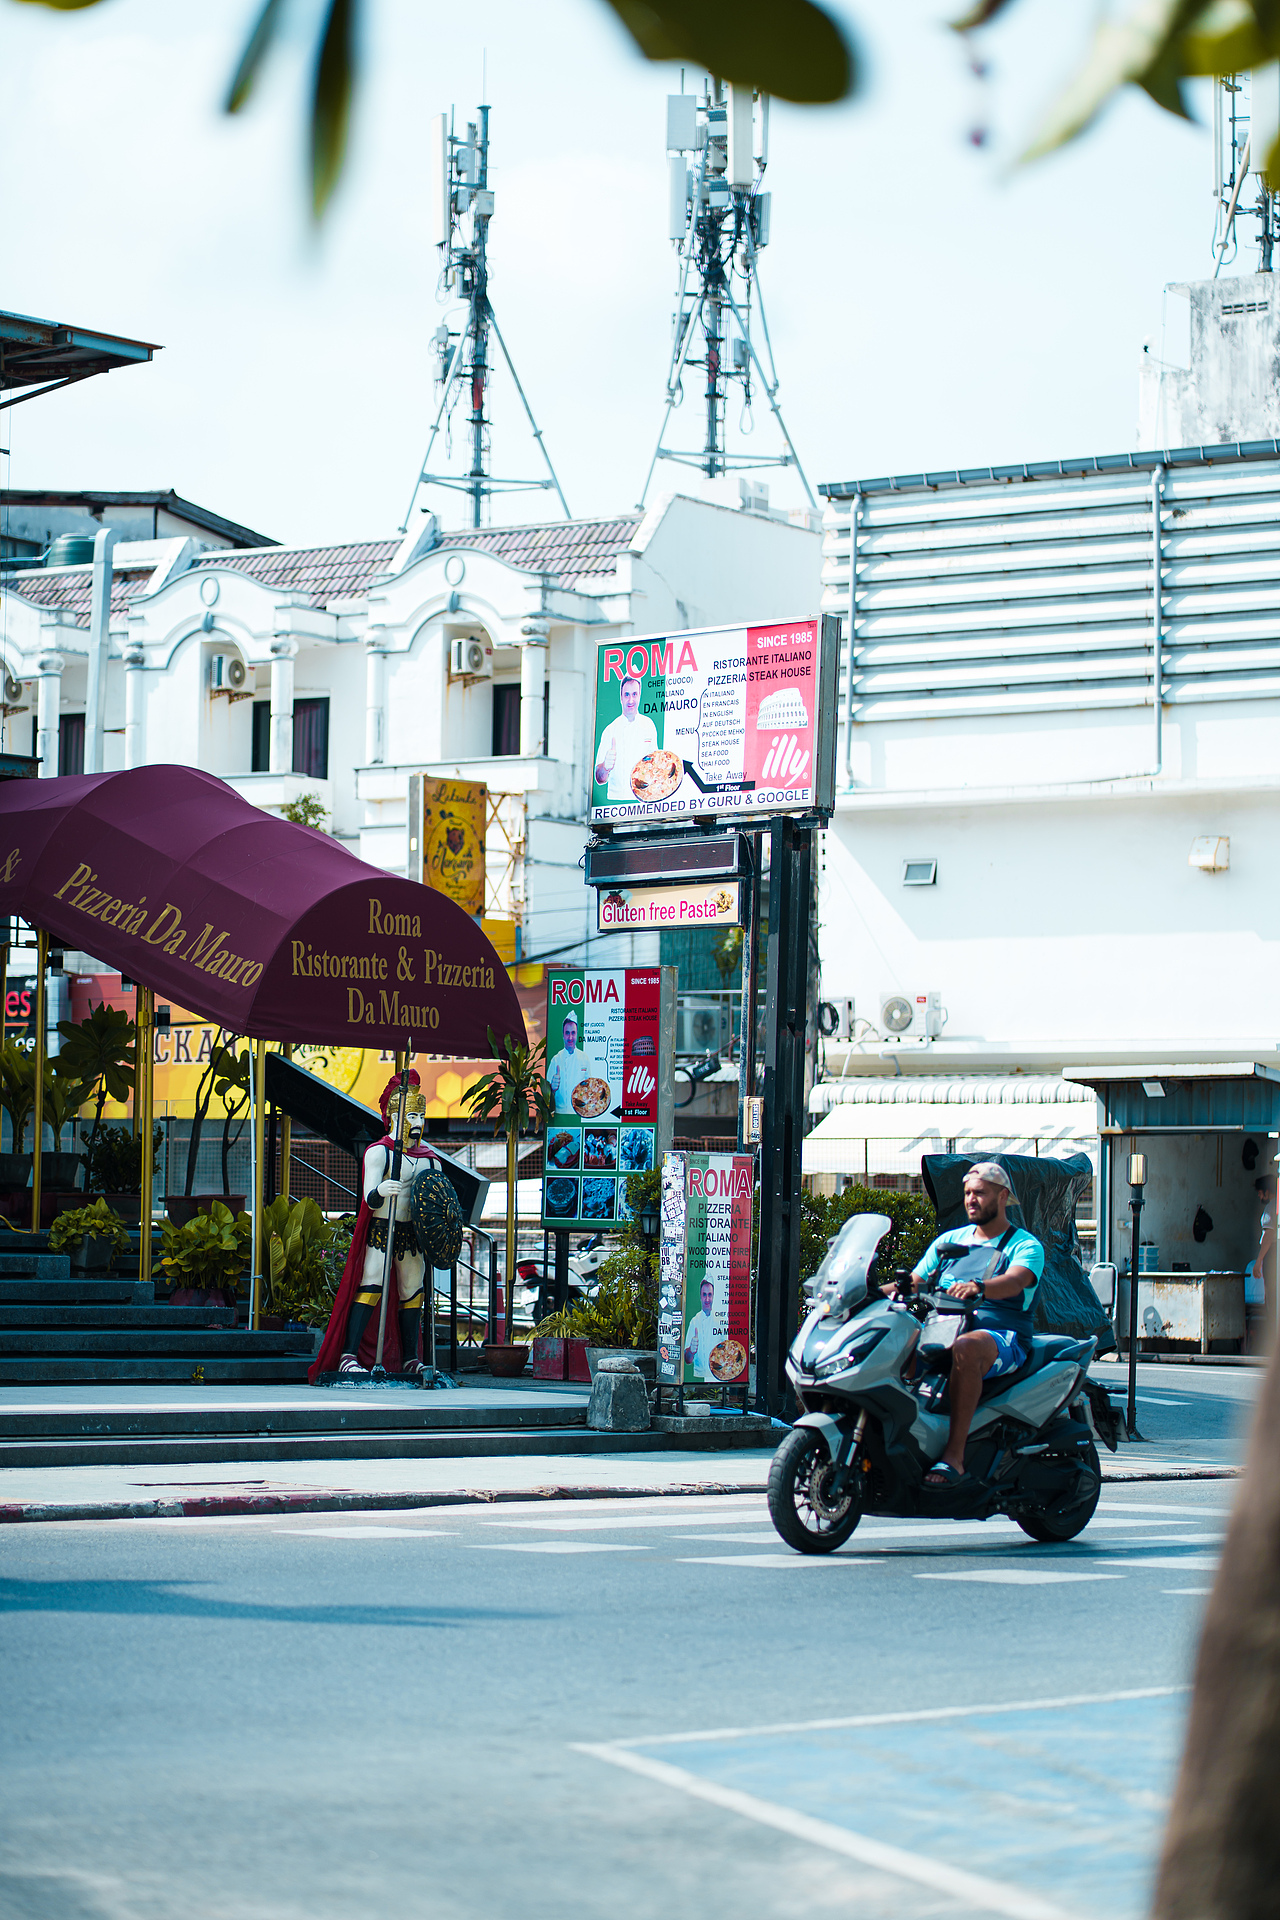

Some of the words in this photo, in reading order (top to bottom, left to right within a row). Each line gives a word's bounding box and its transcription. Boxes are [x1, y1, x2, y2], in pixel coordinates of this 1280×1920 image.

[757, 634, 787, 648] SINCE
[790, 632, 812, 644] 1985
[604, 641, 698, 682] ROMA
[714, 655, 768, 670] RISTORANTE
[772, 651, 812, 662] ITALIANO
[648, 680, 664, 688] CHEF
[666, 676, 693, 687] (CUOCO)
[708, 674, 746, 686] PIZZERIA
[749, 670, 778, 681] STEAK
[780, 666, 810, 678] HOUSE
[656, 689, 684, 698] ITALIANO
[712, 699, 739, 707] FRANCAIS
[644, 703, 658, 714] DA
[660, 698, 698, 712] MAURO
[676, 728, 694, 736] MENU
[762, 734, 810, 788] illy
[705, 772, 722, 782] Take
[726, 771, 748, 782] Away
[595, 800, 686, 819] RECOMMENDED
[690, 798, 705, 810] BY
[708, 795, 742, 807] GURU
[745, 794, 752, 804] &
[757, 789, 808, 804] GOOGLE
[0, 848, 22, 882] &
[368, 898, 422, 938] Roma
[602, 904, 646, 923] Gluten
[649, 902, 676, 920] free
[680, 900, 717, 919] Pasta
[54, 862, 148, 936] Pizzeria
[140, 903, 188, 955] Da
[179, 922, 264, 988] Mauro
[291, 940, 388, 980] Ristorante
[396, 946, 416, 982] &
[424, 949, 495, 989] Pizzeria
[552, 978, 620, 1004] ROMA
[346, 988, 375, 1024] Da
[379, 990, 440, 1028] Mauro
[627, 1065, 655, 1100] illy
[689, 1168, 752, 1198] ROMA
[698, 1204, 741, 1214] PIZZERIA
[689, 1218, 749, 1228] RISTORANTE
[698, 1233, 738, 1242] ITALIANO
[689, 1247, 710, 1256] WOOD
[711, 1247, 730, 1256] OVEN
[733, 1248, 748, 1256] FIRE
[690, 1260, 714, 1268] FORNO
[715, 1260, 720, 1268] A
[722, 1260, 747, 1268] LEGNA
